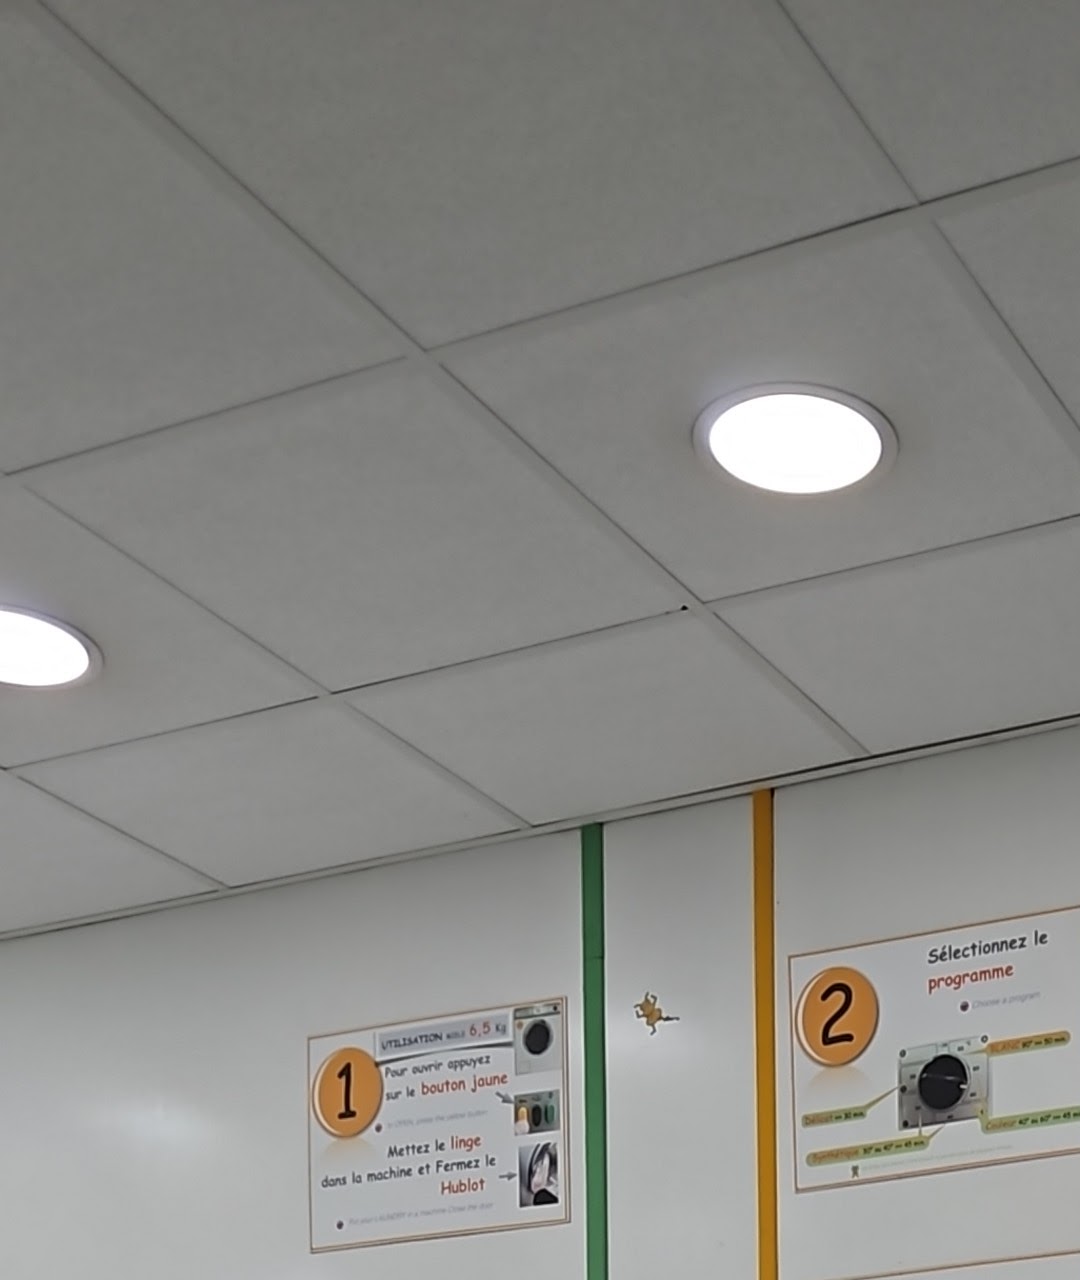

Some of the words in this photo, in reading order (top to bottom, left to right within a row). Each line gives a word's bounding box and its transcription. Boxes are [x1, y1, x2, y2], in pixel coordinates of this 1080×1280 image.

[928, 937, 1027, 964] Sélectionnez
[1034, 929, 1048, 946] le
[928, 965, 1014, 995] programme
[820, 983, 855, 1047] 2
[381, 1032, 443, 1051] UTILISATION
[469, 1021, 491, 1037] 6,5
[385, 1066, 408, 1078] Pour
[412, 1060, 443, 1074] ouvrir
[447, 1055, 491, 1071] appuyez
[337, 1062, 357, 1120] 1
[386, 1090, 402, 1101] sur
[406, 1086, 415, 1097] le
[421, 1079, 466, 1095] bouton
[471, 1074, 508, 1093] jaune
[387, 1145, 430, 1158] Mettez
[435, 1139, 446, 1151] le
[451, 1135, 482, 1151] linge
[321, 1175, 347, 1188] dans
[352, 1171, 362, 1184] la
[367, 1166, 413, 1182] machine
[418, 1163, 431, 1175] et
[436, 1159, 480, 1174] Fermez
[485, 1154, 496, 1168] le
[441, 1178, 485, 1195] Hublot
